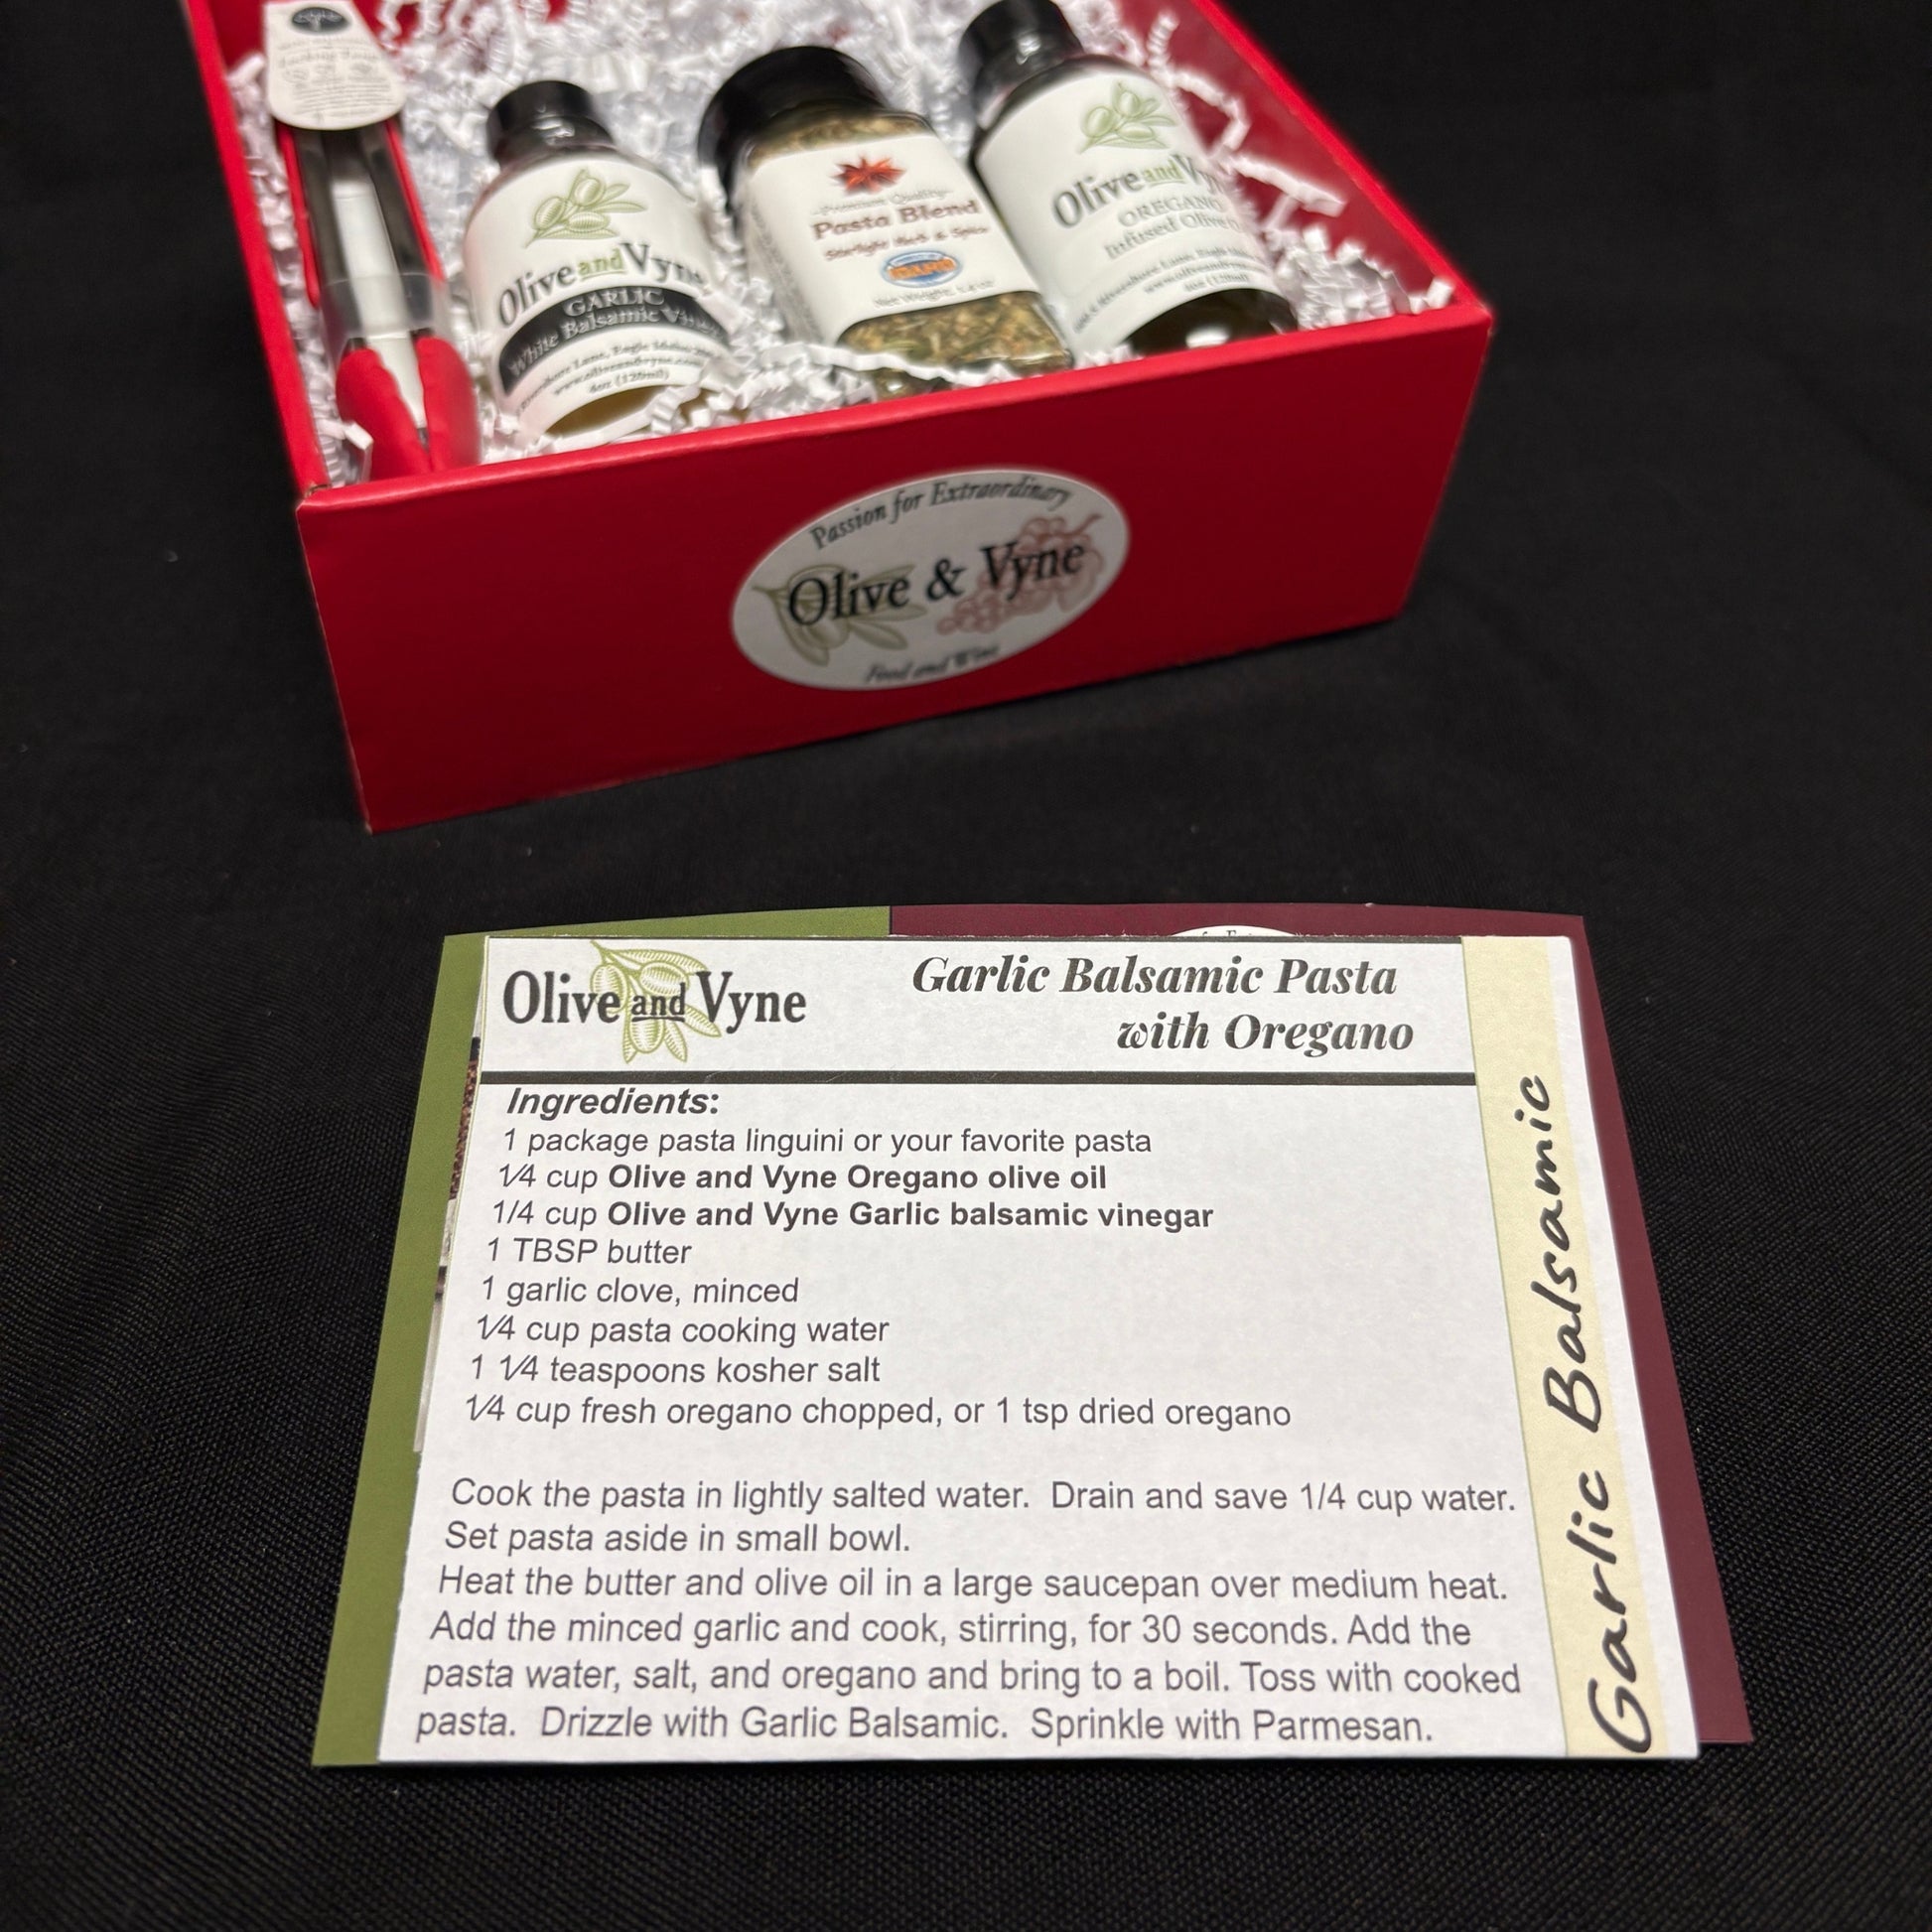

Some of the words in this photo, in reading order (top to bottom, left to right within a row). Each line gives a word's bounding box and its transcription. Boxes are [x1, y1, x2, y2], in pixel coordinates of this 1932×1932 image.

[1052, 170, 1143, 229] Olive
[1143, 159, 1185, 187] and
[1118, 197, 1223, 227] OREGANO
[811, 214, 891, 241] Pasta
[898, 200, 982, 224] Blend
[1103, 216, 1179, 260] Infused
[498, 262, 577, 328] Olive
[578, 249, 626, 279] and
[563, 288, 665, 317] GARLIC
[508, 329, 559, 376] White
[560, 307, 660, 340] Balsamic
[808, 506, 887, 550] Passion
[889, 492, 923, 524] for
[929, 475, 1073, 512] Extraordinary
[788, 569, 911, 626] Olive
[924, 557, 969, 602] &
[980, 539, 1086, 601] Vyne
[912, 954, 1050, 993] Garlic
[1058, 954, 1264, 995] Balsamic
[1273, 958, 1397, 995] Pasta
[502, 970, 621, 1024] Olive
[631, 982, 686, 1022] and
[696, 971, 807, 1035] Vyne
[1116, 1010, 1210, 1049] with
[1224, 1014, 1414, 1058] Oregano
[506, 1087, 720, 1122] Ingredients:
[504, 1127, 516, 1152] 1
[527, 1128, 649, 1159] package
[658, 1129, 736, 1158] pasta
[746, 1127, 844, 1159] linguini
[853, 1133, 883, 1153] or
[891, 1134, 953, 1159] your
[960, 1127, 1065, 1153] favorite
[1075, 1129, 1152, 1159] pasta
[546, 1170, 599, 1195] cup
[609, 1164, 686, 1189] Olive
[695, 1164, 754, 1189] and
[762, 1164, 837, 1195] Vyne
[847, 1164, 979, 1195] Oregano
[988, 1165, 1060, 1189] olive
[1069, 1165, 1107, 1189] oil
[545, 1206, 598, 1232] cup
[608, 1200, 686, 1226] Olive
[695, 1201, 754, 1226] and
[762, 1200, 839, 1232] Vyne
[849, 1200, 940, 1226] Garlic
[950, 1201, 1089, 1227] balsamic
[1097, 1201, 1214, 1234] vinegar
[487, 1236, 499, 1262] 1
[512, 1237, 599, 1264] TBSP
[607, 1238, 693, 1265] butter
[1513, 1073, 1602, 1434] Balsamic
[483, 1275, 494, 1301] 1
[505, 1276, 588, 1308] garlic
[597, 1277, 681, 1308] clove,
[693, 1276, 799, 1304] minced
[526, 1321, 580, 1348] cup
[589, 1316, 671, 1349] pasta
[681, 1315, 796, 1349] cooking
[806, 1316, 891, 1342] water
[472, 1353, 483, 1380] 1
[550, 1355, 706, 1390] teaspoons
[716, 1356, 819, 1383] kosher
[827, 1355, 881, 1383] salt
[516, 1402, 571, 1430] cup
[581, 1396, 656, 1425] fresh
[666, 1403, 792, 1432] oregano
[802, 1396, 942, 1431] chopped,
[954, 1403, 986, 1424] or
[997, 1396, 1008, 1424] 1
[1023, 1397, 1068, 1431] tsp
[1078, 1397, 1154, 1425] dried
[1165, 1404, 1291, 1433] oregano
[452, 1476, 533, 1507] Cook
[543, 1479, 591, 1508] the
[601, 1481, 685, 1515] pasta
[697, 1480, 722, 1509] in
[733, 1480, 823, 1516] lightly
[832, 1479, 925, 1509] salted
[936, 1481, 1030, 1509] water.
[1052, 1480, 1134, 1509] Drain
[1146, 1481, 1203, 1510] and
[1214, 1488, 1288, 1510] save
[1356, 1489, 1413, 1518] cup
[1421, 1484, 1515, 1512] water.
[445, 1520, 499, 1550] Set
[507, 1524, 594, 1558] pasta
[604, 1523, 688, 1552] aside
[699, 1522, 725, 1552] in
[736, 1523, 818, 1552] small
[829, 1522, 909, 1552] bowl.
[439, 1564, 516, 1595] Heat
[525, 1566, 574, 1596] the
[584, 1566, 677, 1596] butter
[685, 1567, 745, 1596] and
[755, 1567, 828, 1596] olive
[839, 1567, 874, 1596] oil
[886, 1567, 911, 1596] in
[923, 1575, 942, 1597] a
[954, 1567, 1033, 1604] large
[1043, 1575, 1199, 1604] saucepan
[1210, 1576, 1281, 1598] over
[1292, 1569, 1419, 1599] medium
[1428, 1570, 1507, 1600] heat.
[429, 1609, 497, 1641] Add
[507, 1610, 556, 1642] the
[567, 1611, 683, 1642] minced
[693, 1611, 780, 1649] garlic
[790, 1611, 850, 1642] and
[862, 1612, 946, 1647] cook,
[959, 1612, 1077, 1651] stirring,
[1087, 1612, 1132, 1644] for
[1142, 1613, 1181, 1644] 30
[1192, 1613, 1337, 1645] seconds.
[1346, 1614, 1411, 1645] Add
[1420, 1615, 1471, 1646] the
[1568, 1469, 1651, 1755] Garlic
[422, 1658, 514, 1695] pasta
[525, 1659, 620, 1694] water,
[632, 1658, 697, 1694] salt,
[710, 1658, 770, 1689] and
[781, 1665, 916, 1698] oregano
[927, 1659, 988, 1690] and
[1001, 1659, 1080, 1699] bring
[1091, 1660, 1122, 1691] to
[1133, 1667, 1153, 1691] a
[1165, 1660, 1229, 1692] boil.
[1239, 1661, 1316, 1693] Toss
[1325, 1661, 1393, 1693] with
[1404, 1662, 1521, 1694] cooked
[416, 1706, 515, 1743] pasta.
[540, 1706, 652, 1737] Drizzle
[663, 1705, 728, 1737] with
[741, 1705, 837, 1737] Garlic
[849, 1706, 1008, 1739] Balsamic.
[1031, 1707, 1165, 1746] Sprinkle
[1174, 1708, 1240, 1740] with
[1253, 1709, 1433, 1741] Parmesan.
